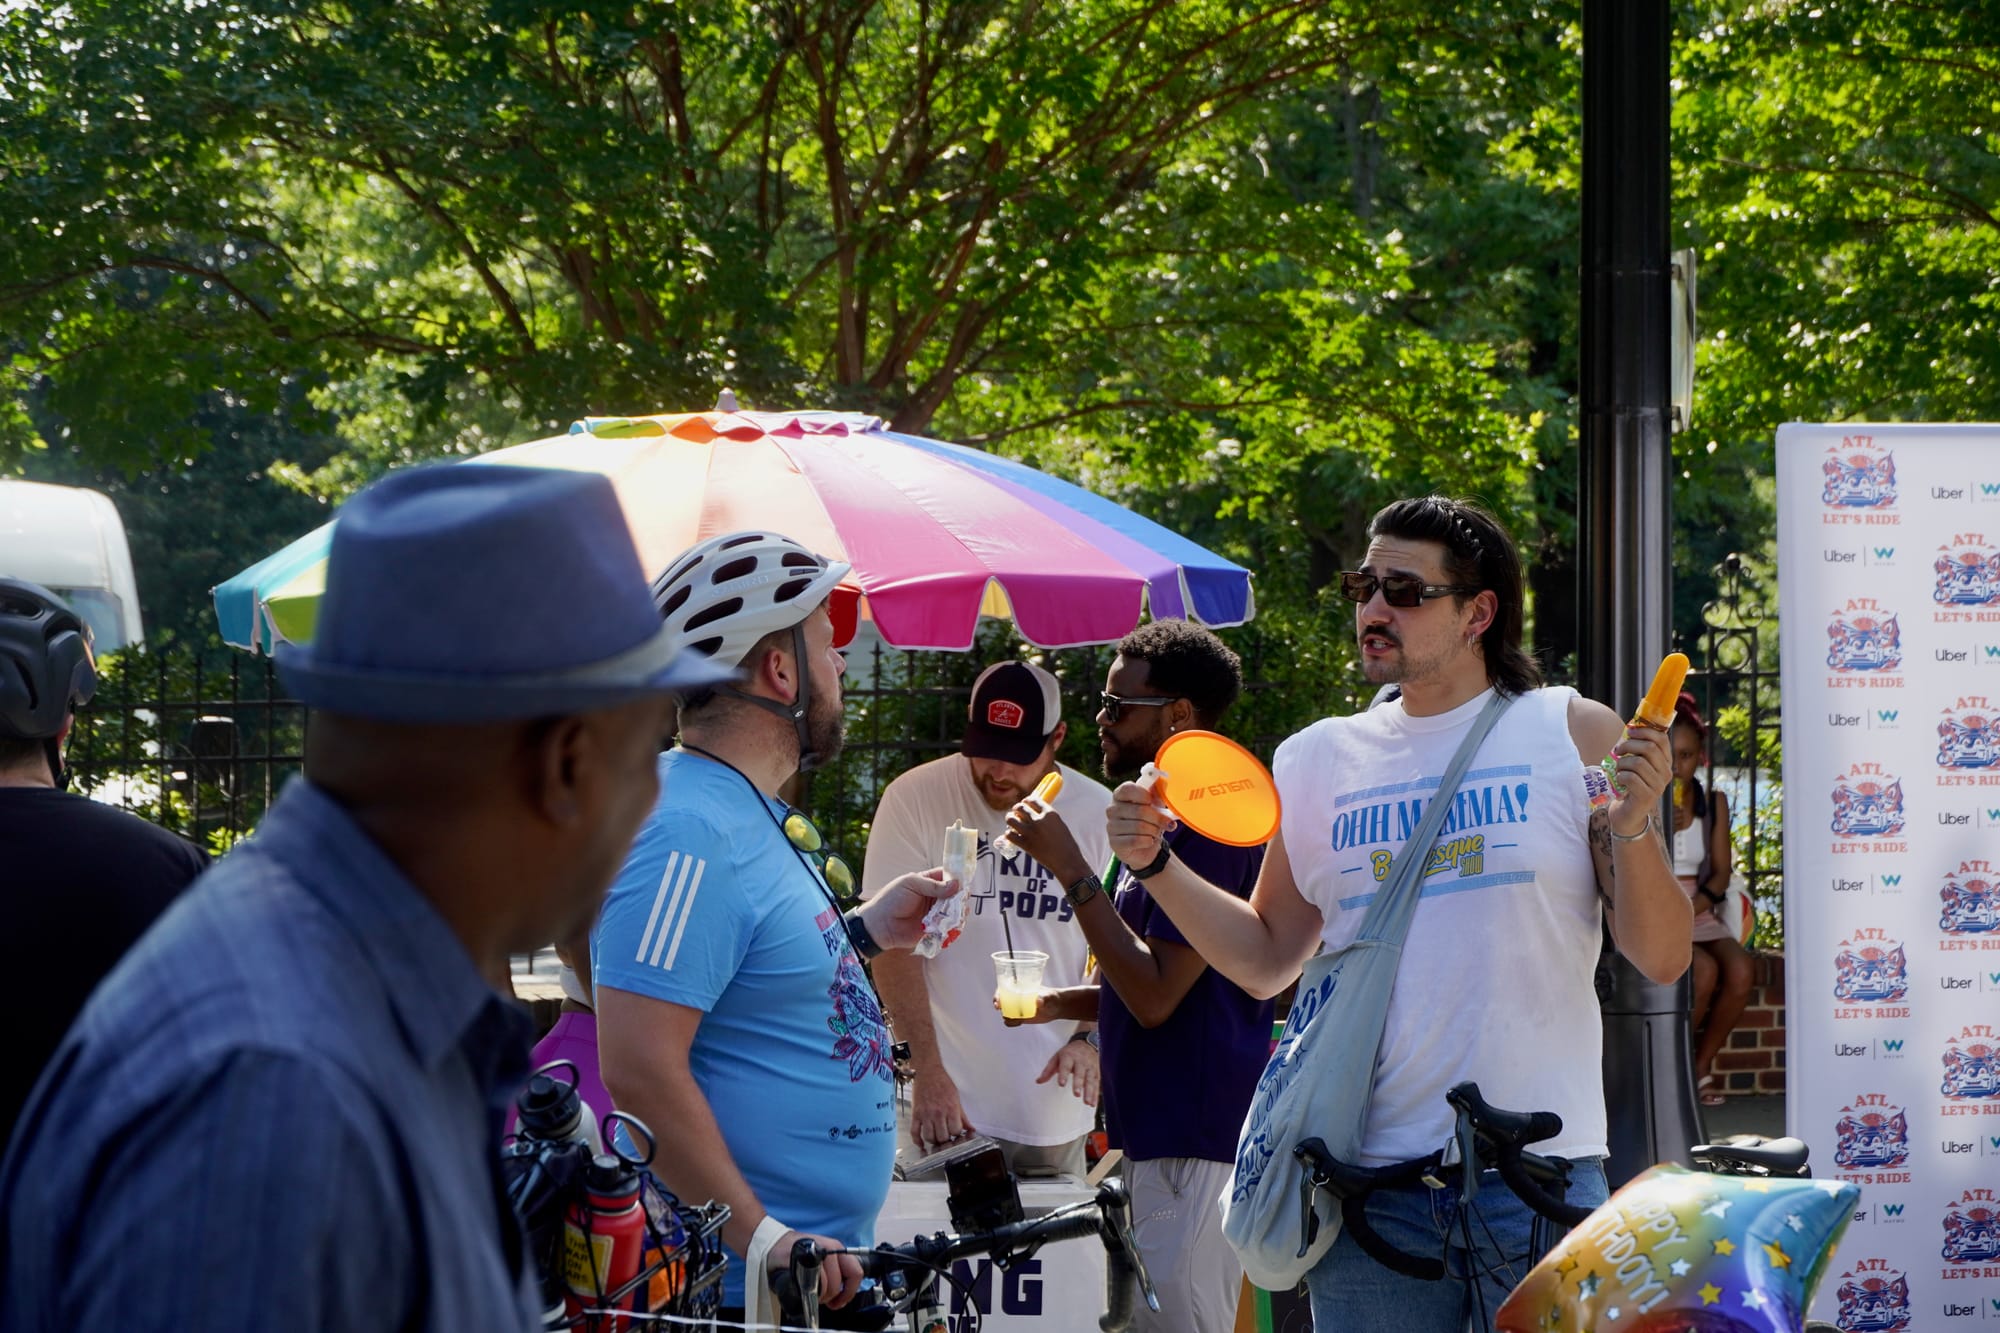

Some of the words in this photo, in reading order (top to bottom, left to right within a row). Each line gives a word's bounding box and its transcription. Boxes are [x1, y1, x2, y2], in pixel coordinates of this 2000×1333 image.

[1842, 434, 1876, 449] ATL
[1931, 487, 1964, 500] Uber
[1823, 513, 1862, 525] LET'S
[1865, 513, 1900, 525] RIDE
[1953, 532, 1987, 547] ATL
[1823, 549, 1857, 563] Uber
[1846, 597, 1881, 612] ATL
[1934, 611, 1973, 623] LET'S
[1976, 611, 2000, 623] RID
[1935, 649, 1968, 662] Uber
[1827, 676, 1866, 689] LET'S
[1869, 676, 1905, 689] RIDE
[1956, 695, 1990, 709] ATL
[1828, 713, 1861, 727] Uber
[1850, 762, 1884, 776] ATL
[1936, 774, 1975, 787] LET'S
[1332, 802, 1391, 851] OHH
[1397, 783, 1529, 843] MMMA!
[1938, 812, 1971, 825] Uber
[1831, 842, 1870, 854] LET'S
[1872, 841, 1908, 854] RIDE
[1000, 851, 1055, 880] KIN
[1459, 855, 1484, 877] SHOW
[1958, 860, 1992, 874] ATL
[1027, 878, 1047, 893] OF
[1831, 879, 1864, 892] Uber
[999, 890, 1073, 923] POPS
[1853, 927, 1887, 942] ATL
[1939, 939, 1978, 951] LET'S
[1940, 976, 1973, 990] Uber
[1834, 1007, 1873, 1020] LET'S
[1875, 1007, 1911, 1019] RIDE
[1960, 1024, 1995, 1039] ATL
[1834, 1043, 1867, 1057] Uber
[1855, 1093, 1889, 1108] ATL
[1941, 1104, 1980, 1116] LET'S
[1941, 1141, 1974, 1154] Uber
[1875, 1171, 1911, 1185] RIDE
[1961, 1188, 1996, 1203] ATL
[1852, 1210, 1867, 1222] er
[1855, 1258, 1890, 1273] ATL
[1942, 1268, 1981, 1281] LET'S
[1943, 1303, 1976, 1317] Uber
